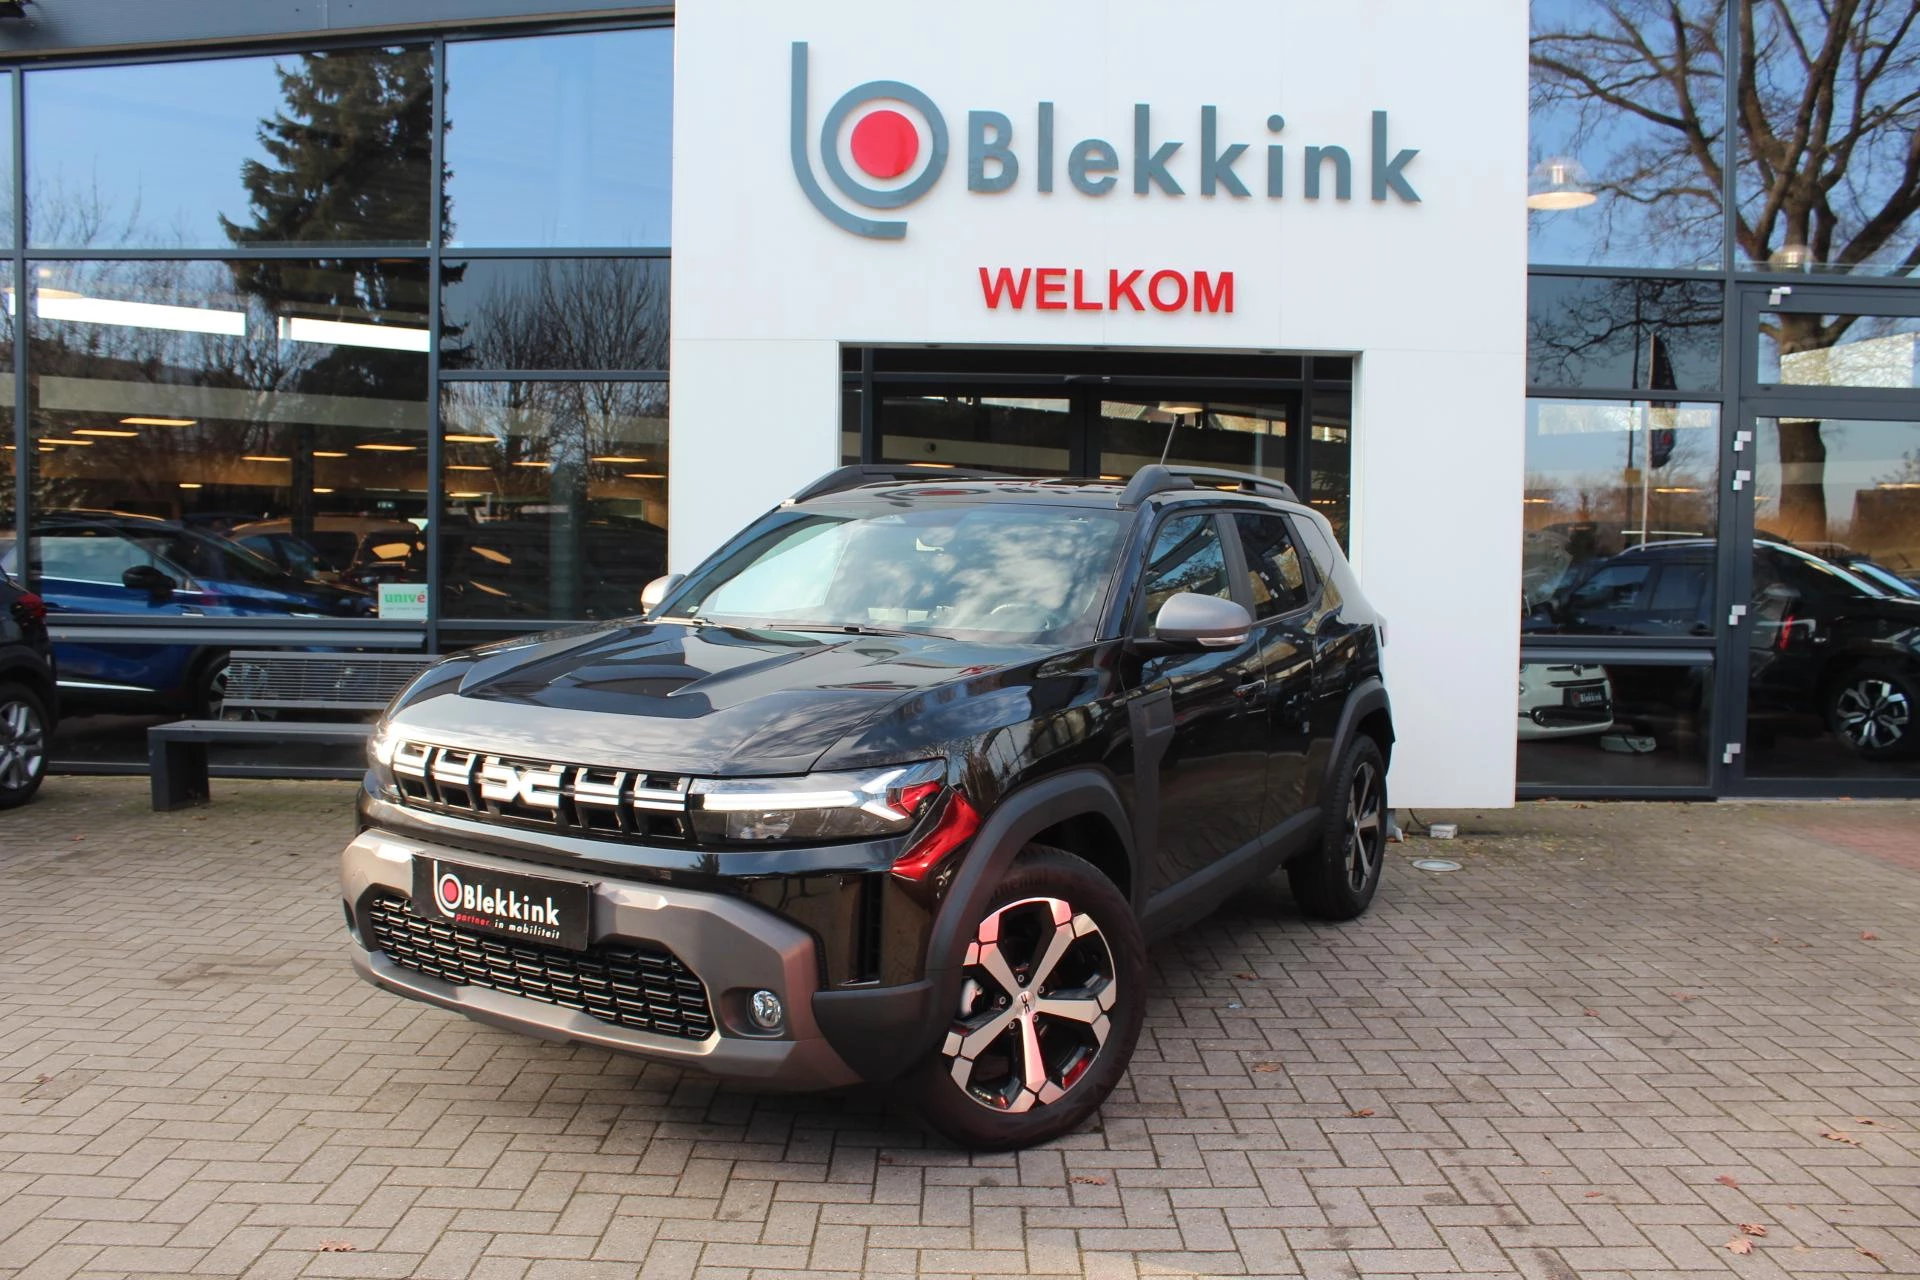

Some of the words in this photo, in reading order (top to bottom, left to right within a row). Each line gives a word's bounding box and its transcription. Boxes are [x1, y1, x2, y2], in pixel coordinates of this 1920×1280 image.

[967, 101, 1422, 203] Blekkink
[978, 266, 1235, 313] WELKOM
[456, 913, 491, 927] partner
[495, 919, 504, 929] in
[509, 922, 560, 940] mobiliteit
[463, 884, 560, 926] Blekkink
